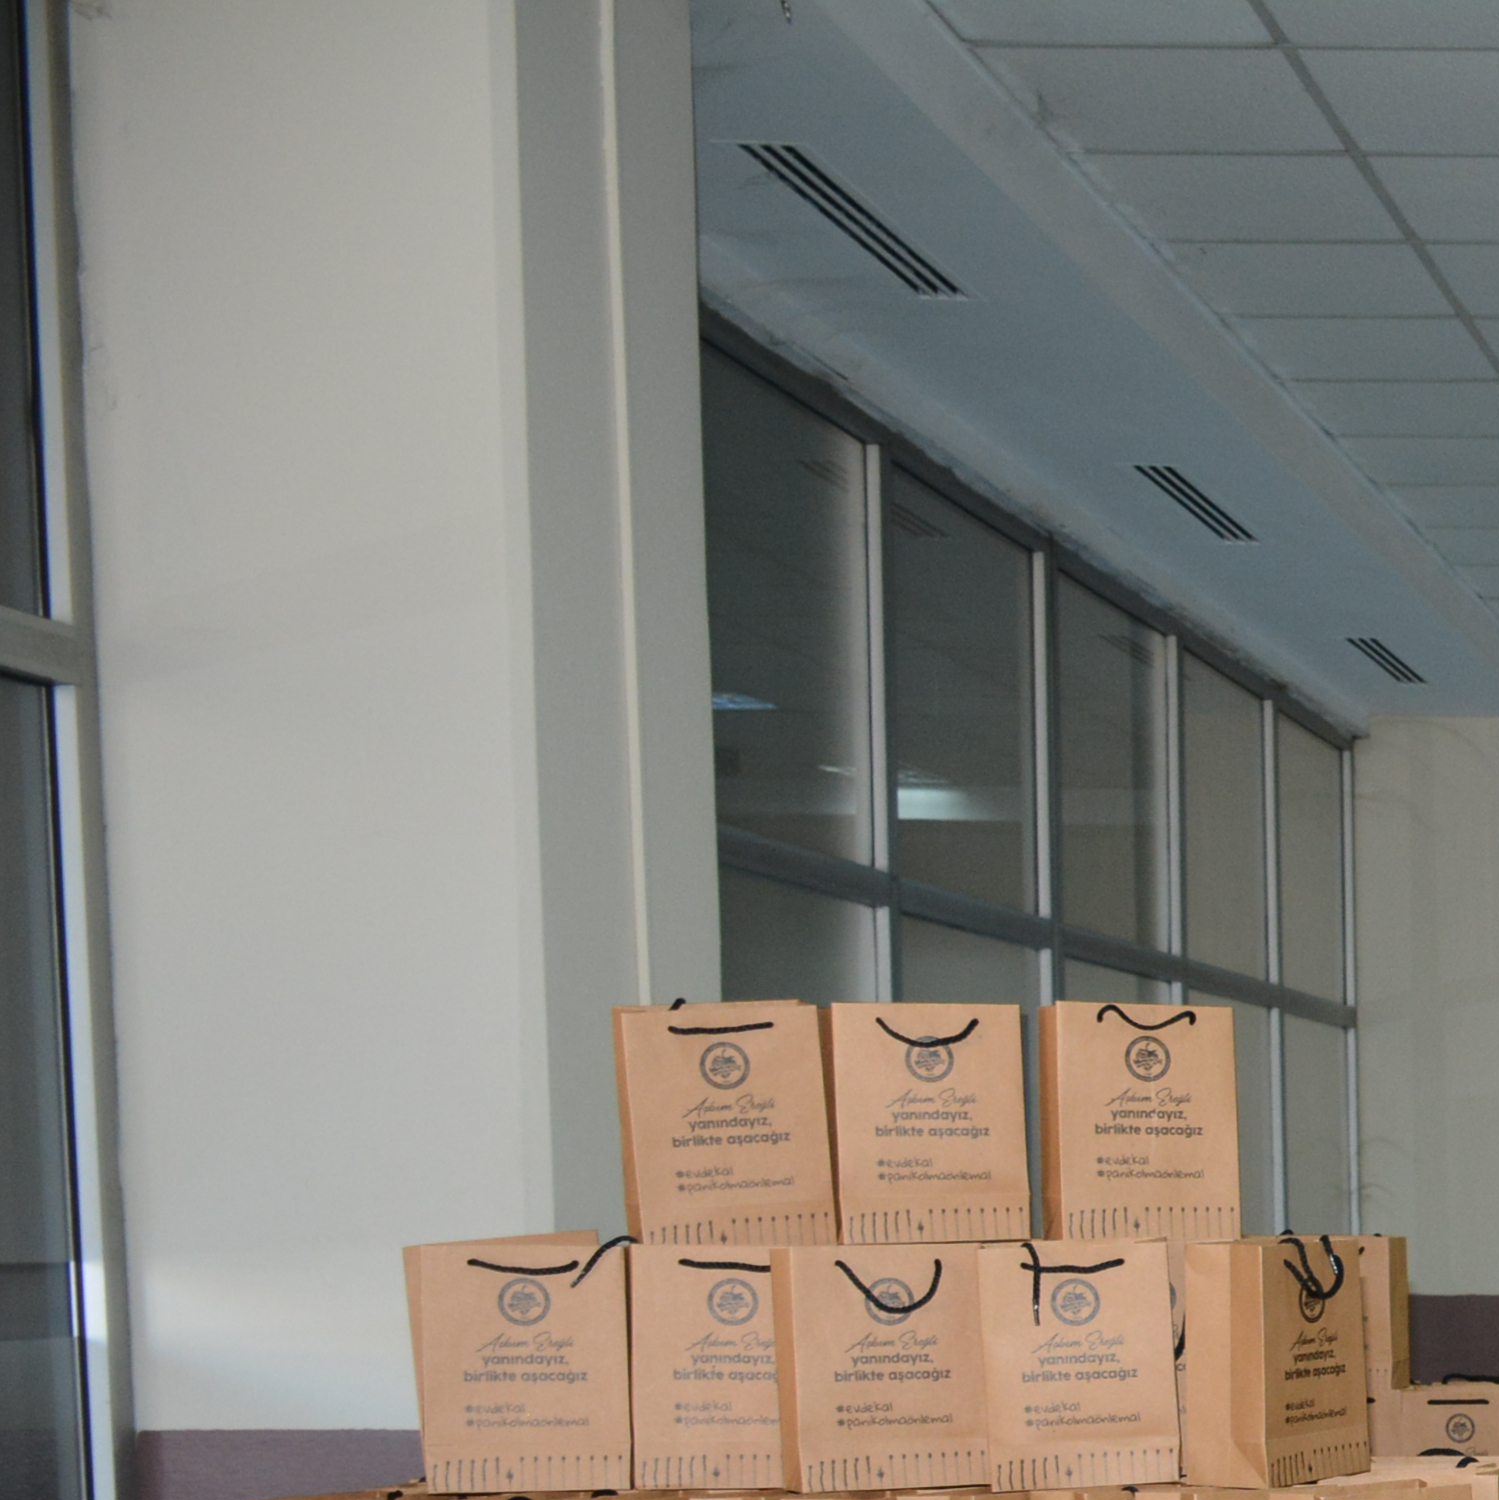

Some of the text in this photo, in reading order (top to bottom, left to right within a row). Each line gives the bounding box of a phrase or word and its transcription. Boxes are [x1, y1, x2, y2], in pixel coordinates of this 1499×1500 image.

[1110, 1108, 1186, 1121] yanındayız,
[688, 1116, 771, 1132] yanındayız,
[1094, 1122, 1203, 1137] birlikte aşacağız
[671, 1130, 790, 1147] birlikte aşacağız
[1095, 1154, 1148, 1164] #evdekal
[675, 1166, 733, 1178] #evdekal
[481, 1353, 568, 1367] yanındayız,
[1037, 1352, 1119, 1367] yanındayız,
[463, 1369, 587, 1384] birlikte aşacağız
[1021, 1366, 1138, 1382] birlikte aşacağız
[1023, 1401, 1080, 1413] #evdekal
